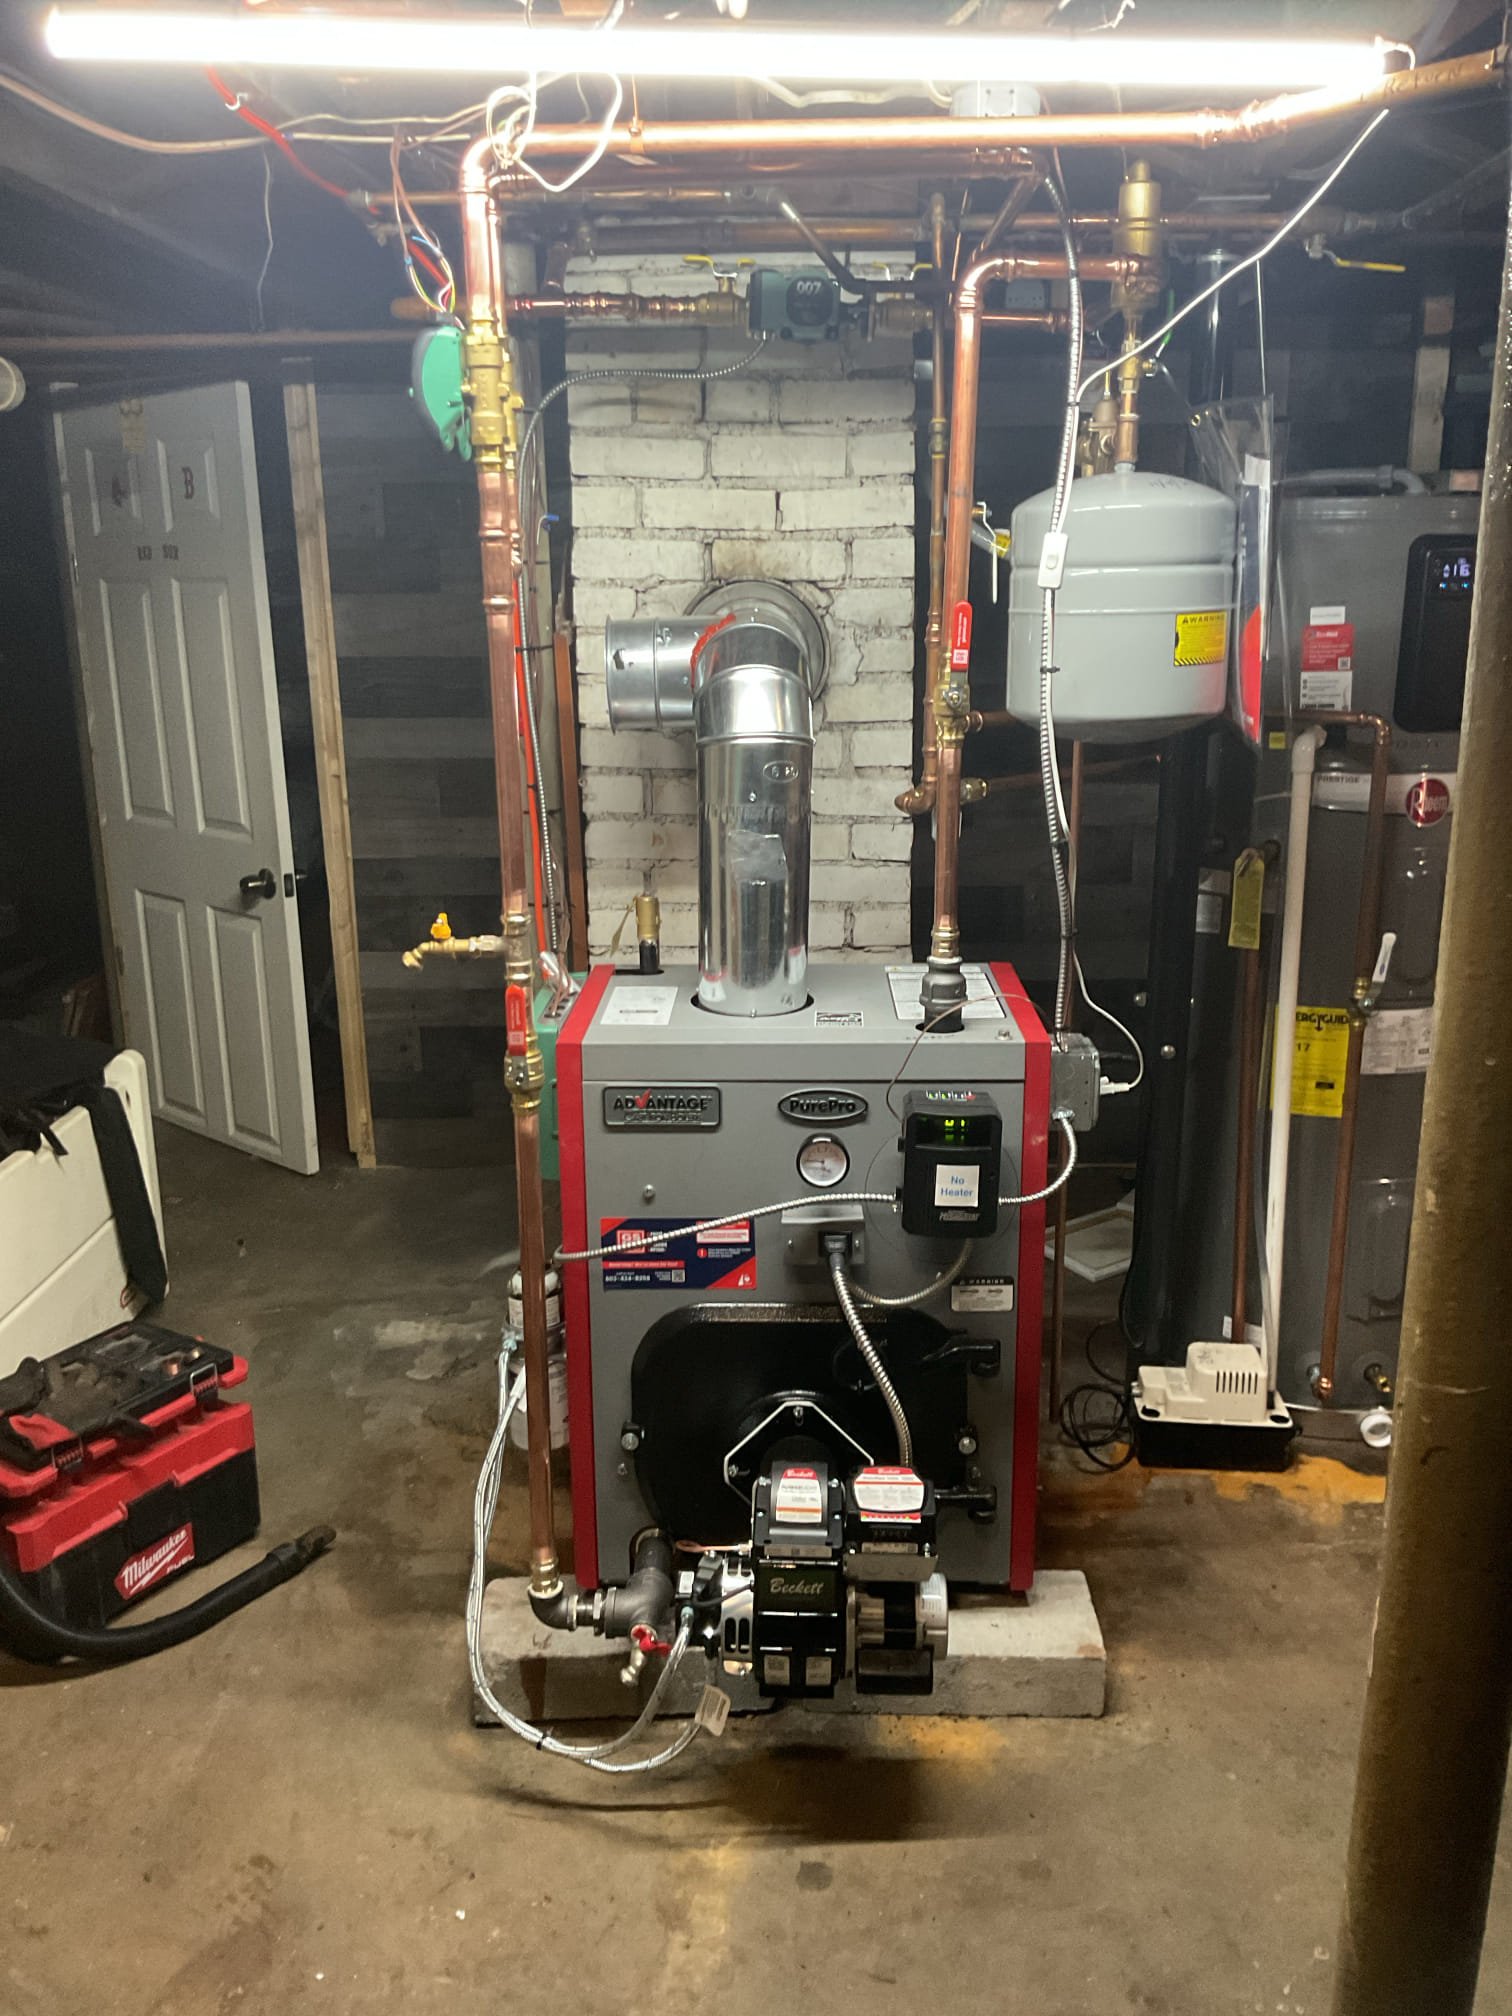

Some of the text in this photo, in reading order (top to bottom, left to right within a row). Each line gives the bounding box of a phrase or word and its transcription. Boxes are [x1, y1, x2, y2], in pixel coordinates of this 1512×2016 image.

[797, 280, 822, 296] 007
[613, 1088, 710, 1110] ADVANTAGE
[789, 1098, 857, 1113] PurePro
[950, 1175, 965, 1185] No
[940, 1188, 973, 1197] Heater
[121, 1529, 188, 1590] Milwaukee
[770, 1577, 825, 1595] Beckett
